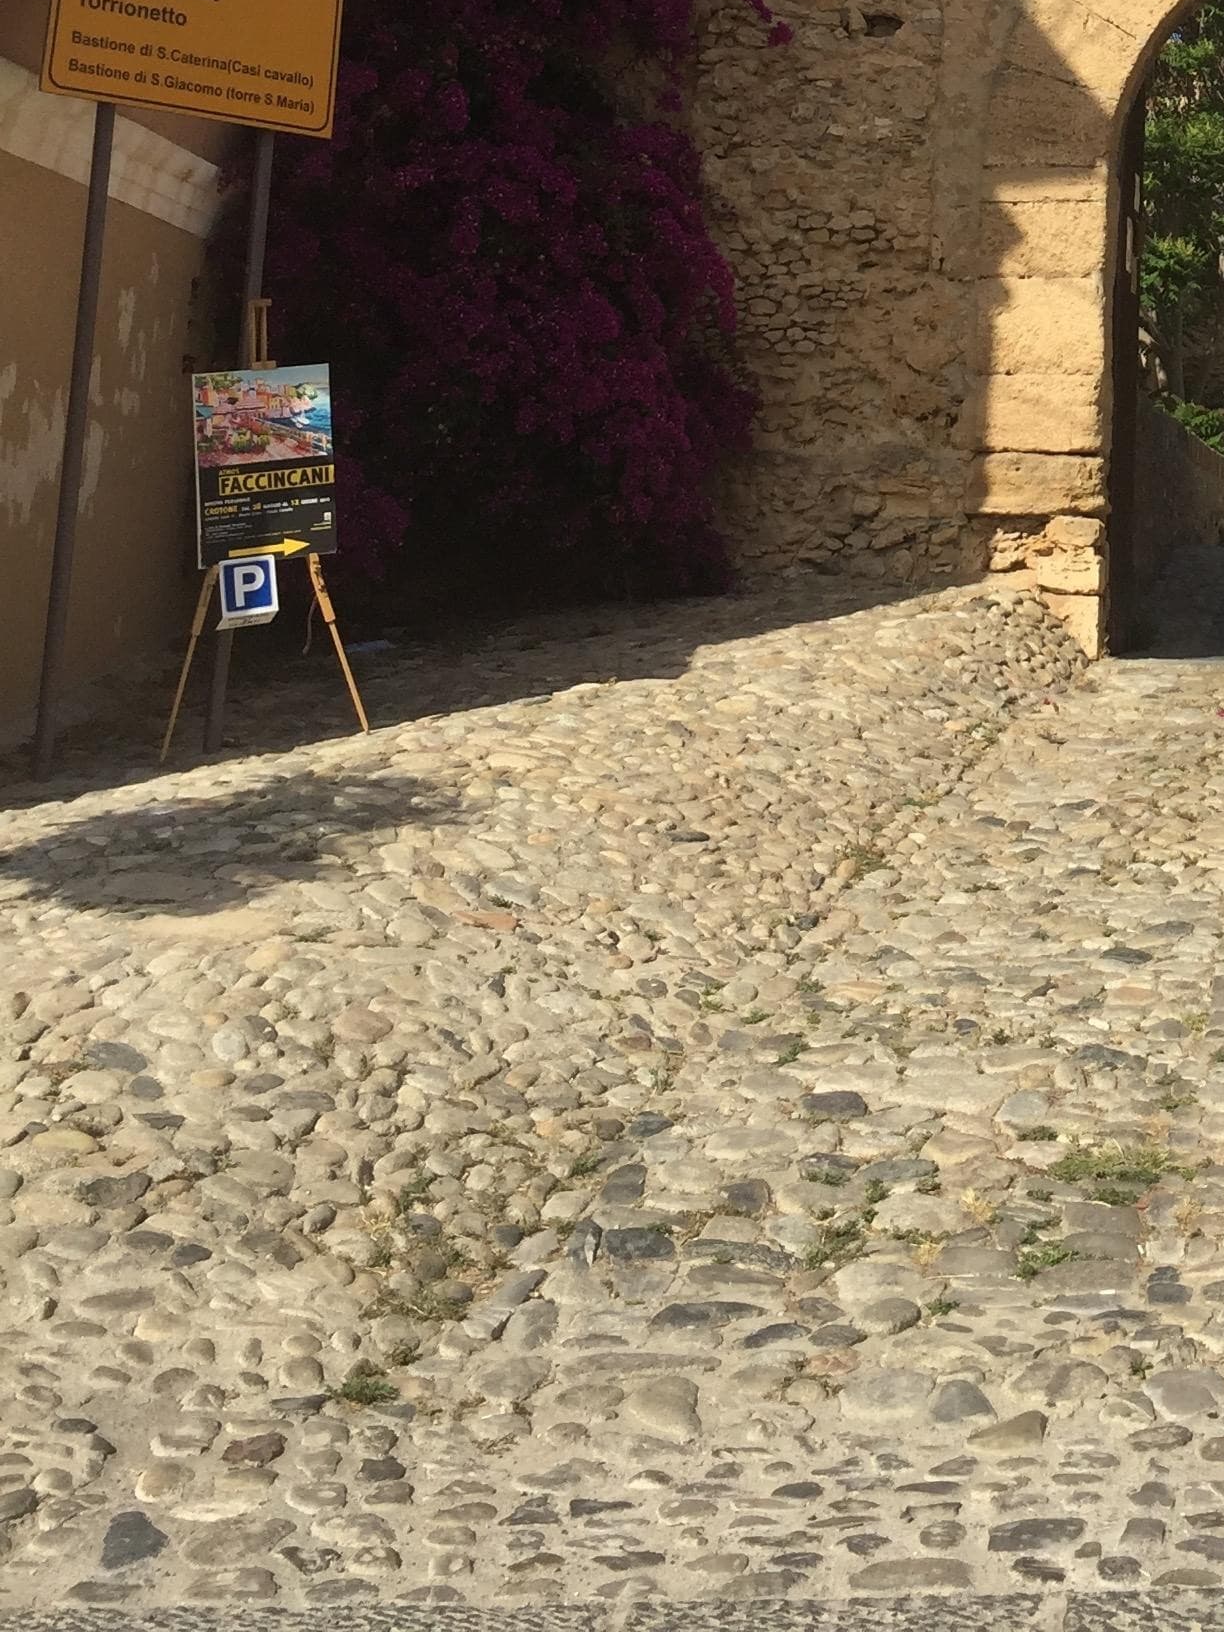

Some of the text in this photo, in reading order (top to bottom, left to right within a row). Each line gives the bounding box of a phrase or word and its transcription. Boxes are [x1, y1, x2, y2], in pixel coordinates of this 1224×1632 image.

[68, 58, 130, 81] Bastione
[134, 71, 147, 84] di
[226, 86, 262, 104] (torre
[71, 30, 136, 54] Bastione
[139, 43, 153, 57] di
[264, 68, 314, 89] cavallo)
[220, 466, 330, 495] FACCINCANI
[233, 565, 265, 608] P
